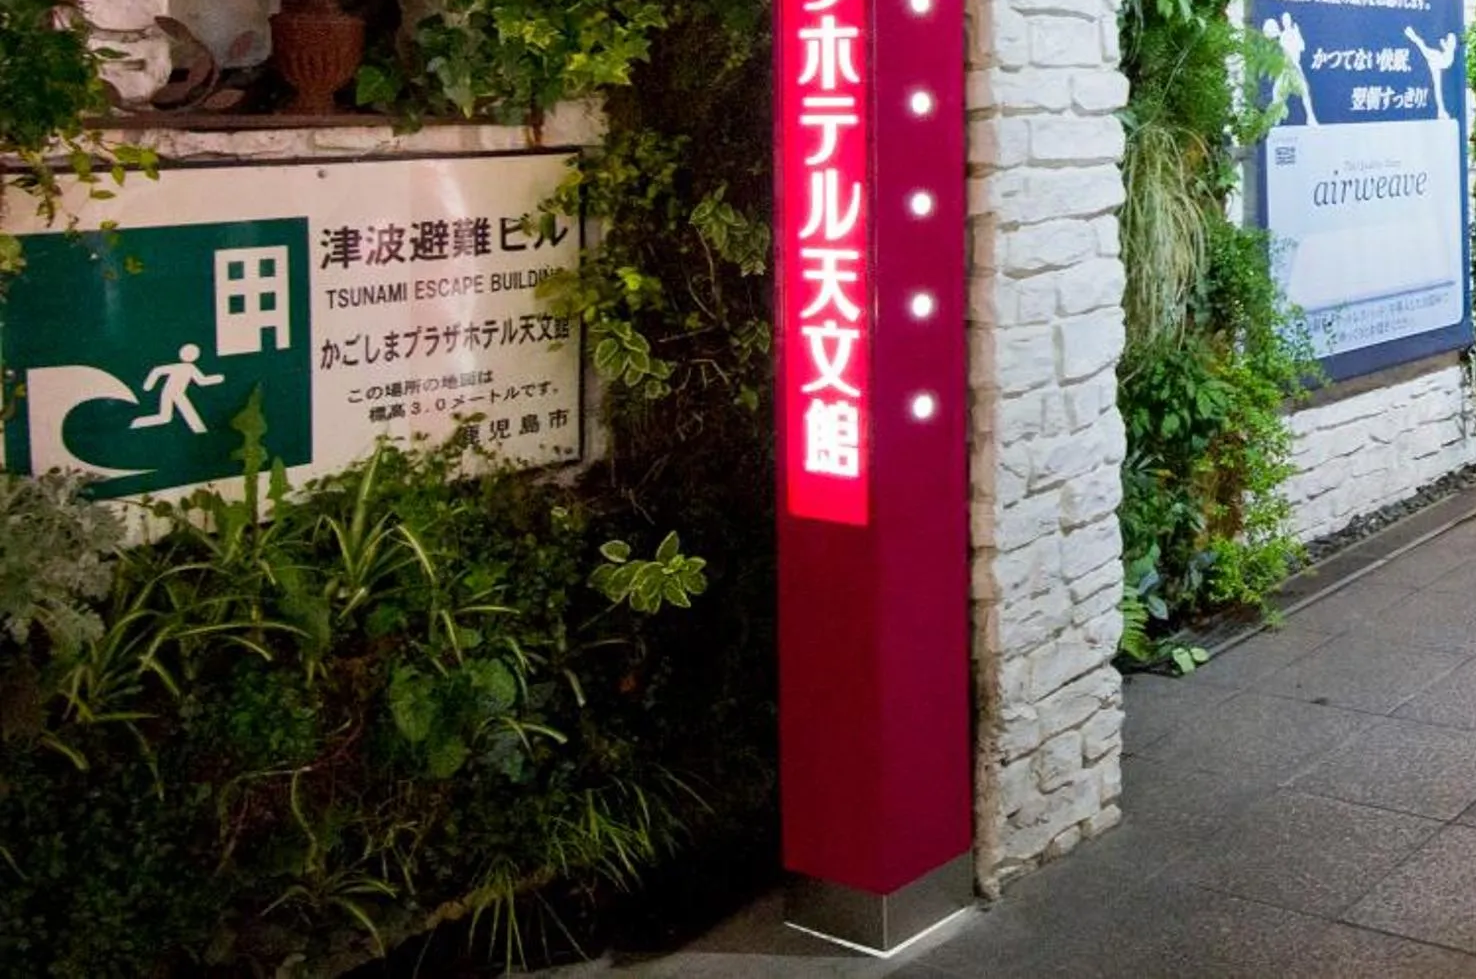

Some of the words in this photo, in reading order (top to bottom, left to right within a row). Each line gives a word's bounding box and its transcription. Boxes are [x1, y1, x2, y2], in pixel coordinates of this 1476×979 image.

[1313, 169, 1428, 208] airweave
[320, 213, 569, 270] 津波避難ビル
[326, 282, 408, 310] TSUNAMI
[414, 274, 485, 300] ESCAPE
[320, 313, 570, 370] かごしまプラザホテル天文館
